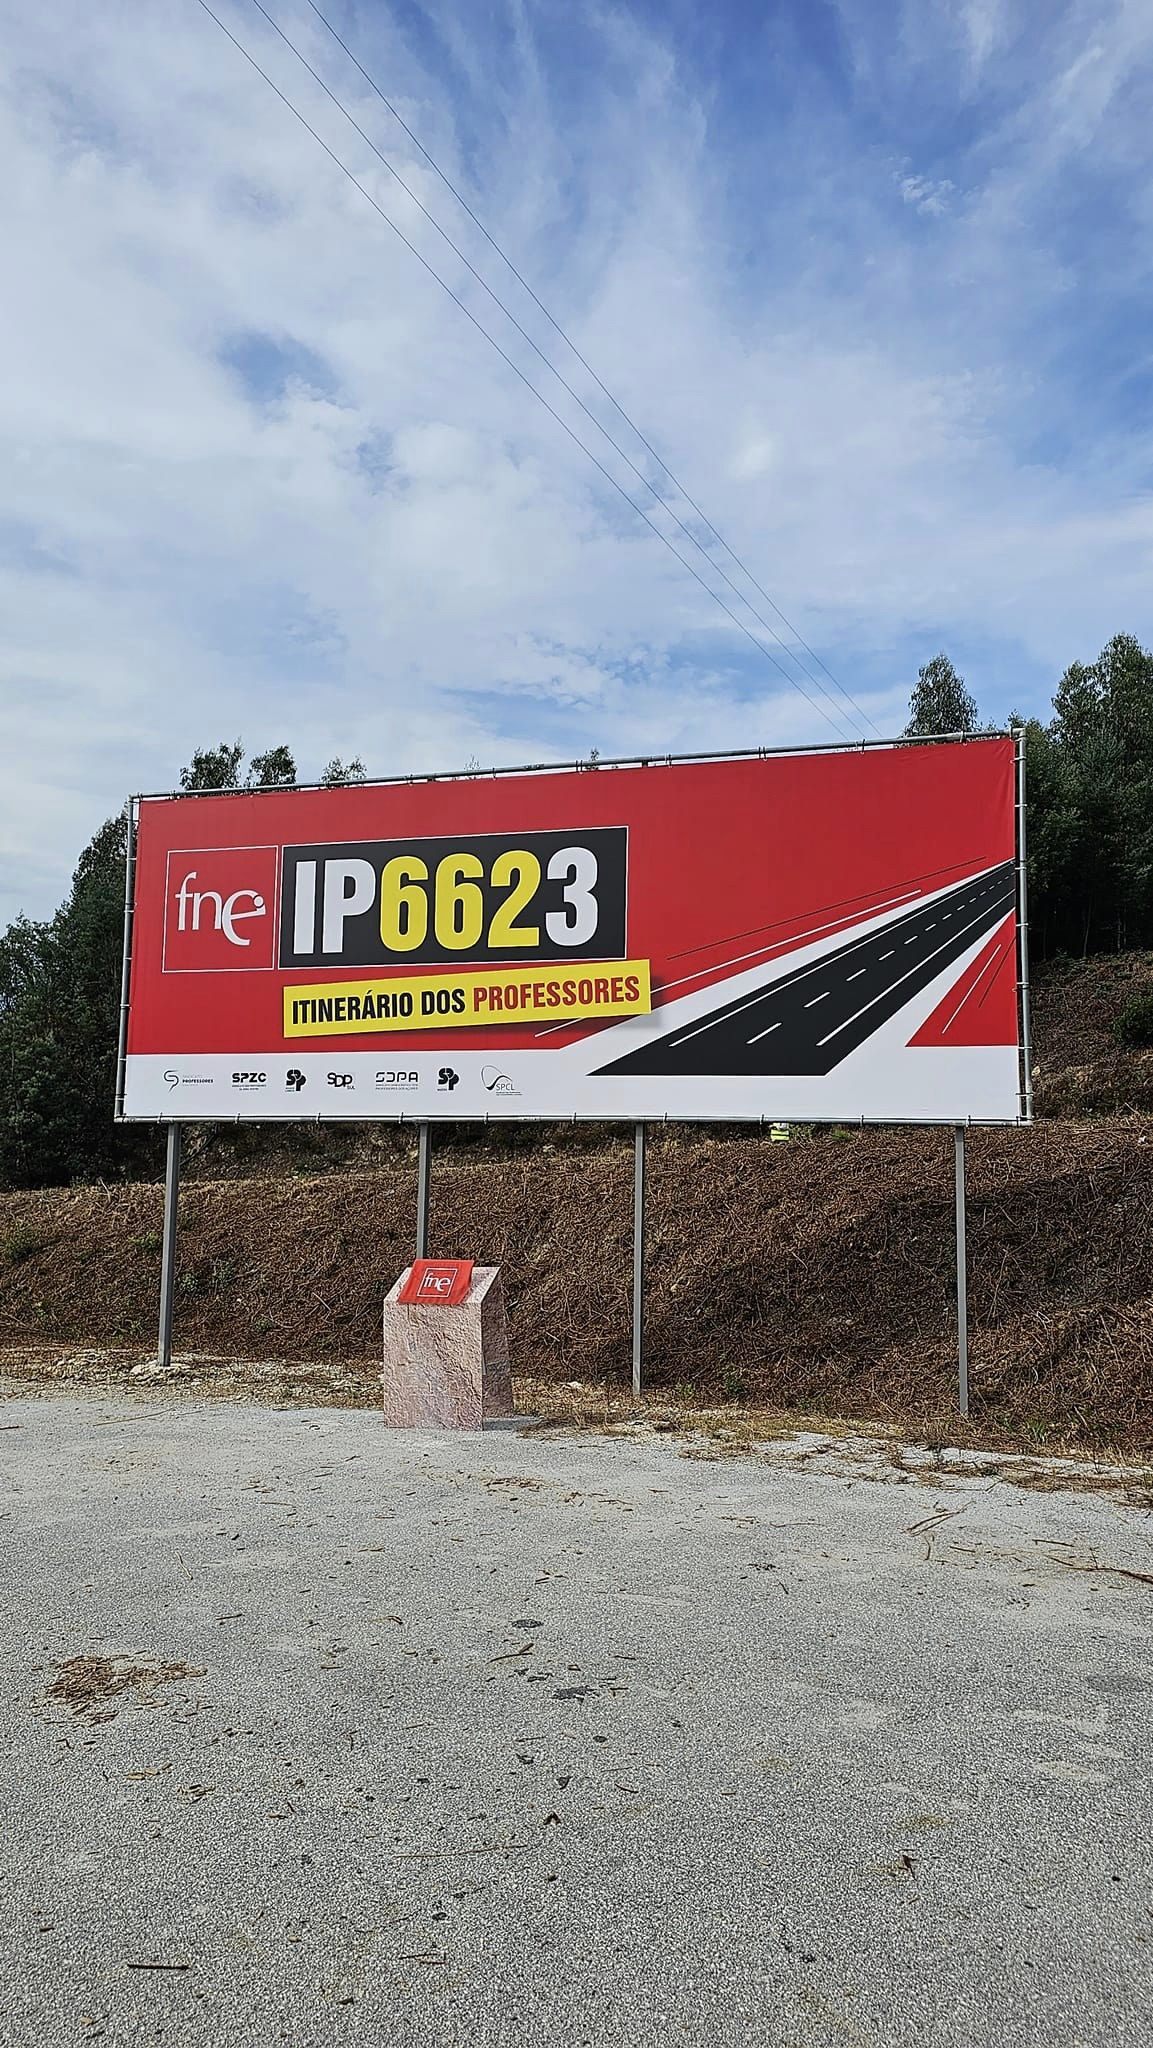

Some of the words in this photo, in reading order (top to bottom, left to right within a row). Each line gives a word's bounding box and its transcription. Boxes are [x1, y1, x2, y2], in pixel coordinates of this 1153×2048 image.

[175, 872, 267, 946] fne
[292, 846, 599, 955] IP6623
[291, 990, 414, 1025] ITINERÁRIO
[421, 988, 466, 1014] DOS
[473, 975, 641, 1012] PROFESSORES
[232, 1072, 267, 1083] SPZC
[327, 1072, 353, 1087] SDP
[495, 1083, 516, 1091] SPCL
[424, 1272, 451, 1292] fne
